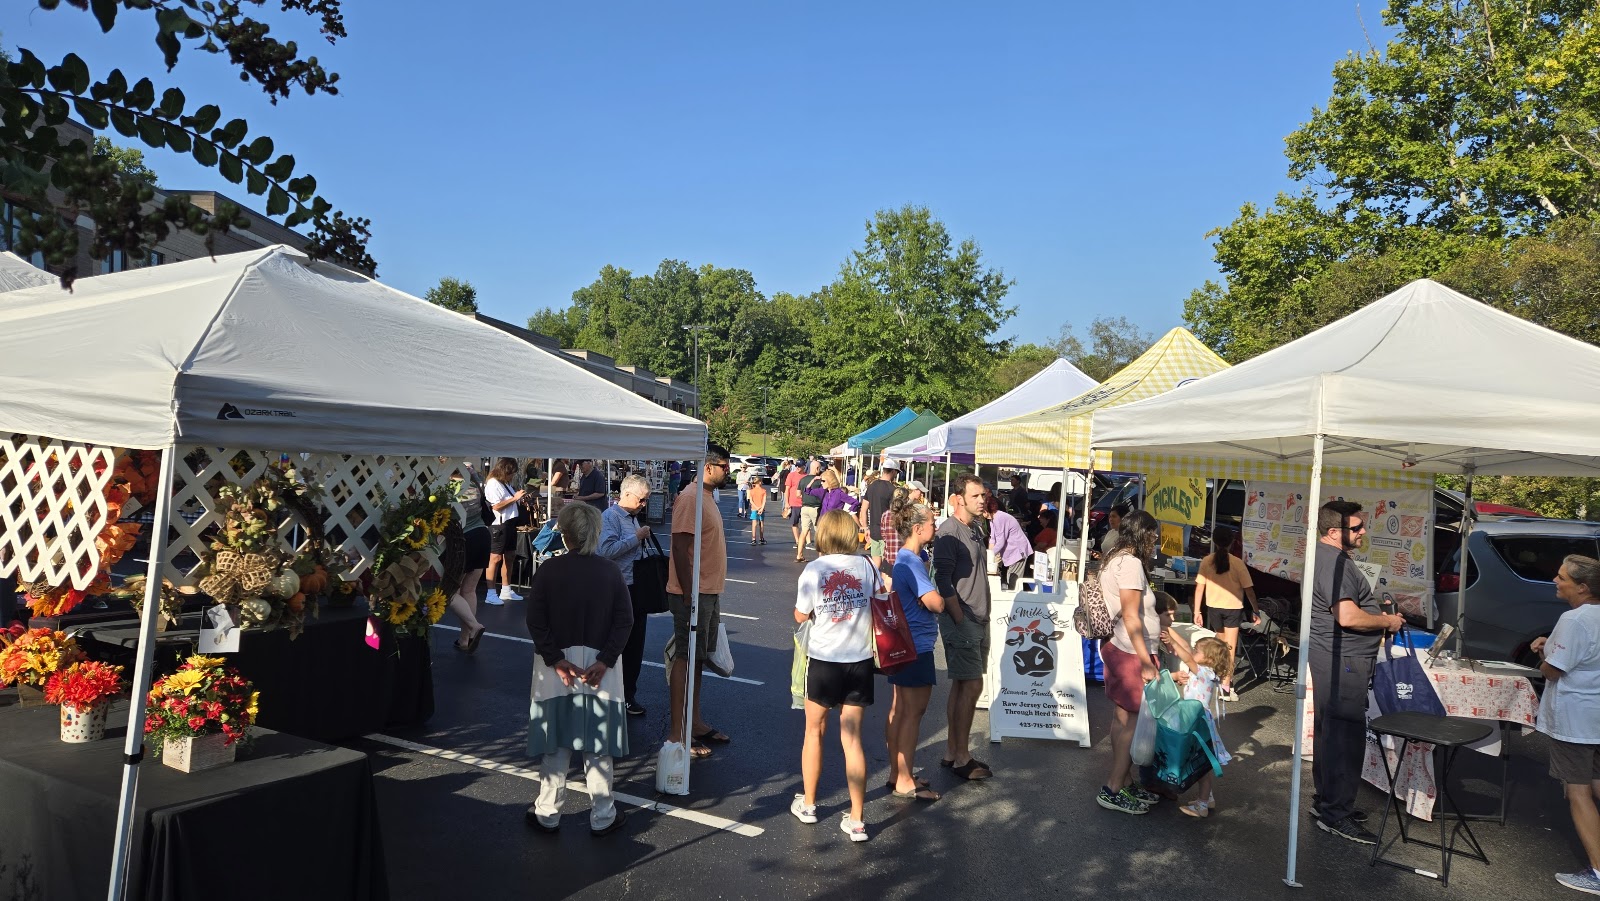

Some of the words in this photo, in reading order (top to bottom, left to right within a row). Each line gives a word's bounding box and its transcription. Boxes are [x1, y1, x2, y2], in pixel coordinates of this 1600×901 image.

[1153, 486, 1192, 520] PICKLES
[996, 612, 1018, 627] The
[1015, 606, 1042, 619] Milk
[1030, 688, 1054, 699] Family
[1056, 690, 1076, 699] Farm
[1002, 700, 1018, 708] Raw
[1019, 701, 1041, 710] Jersey
[1059, 703, 1076, 711] Milk
[1004, 708, 1033, 717] Through
